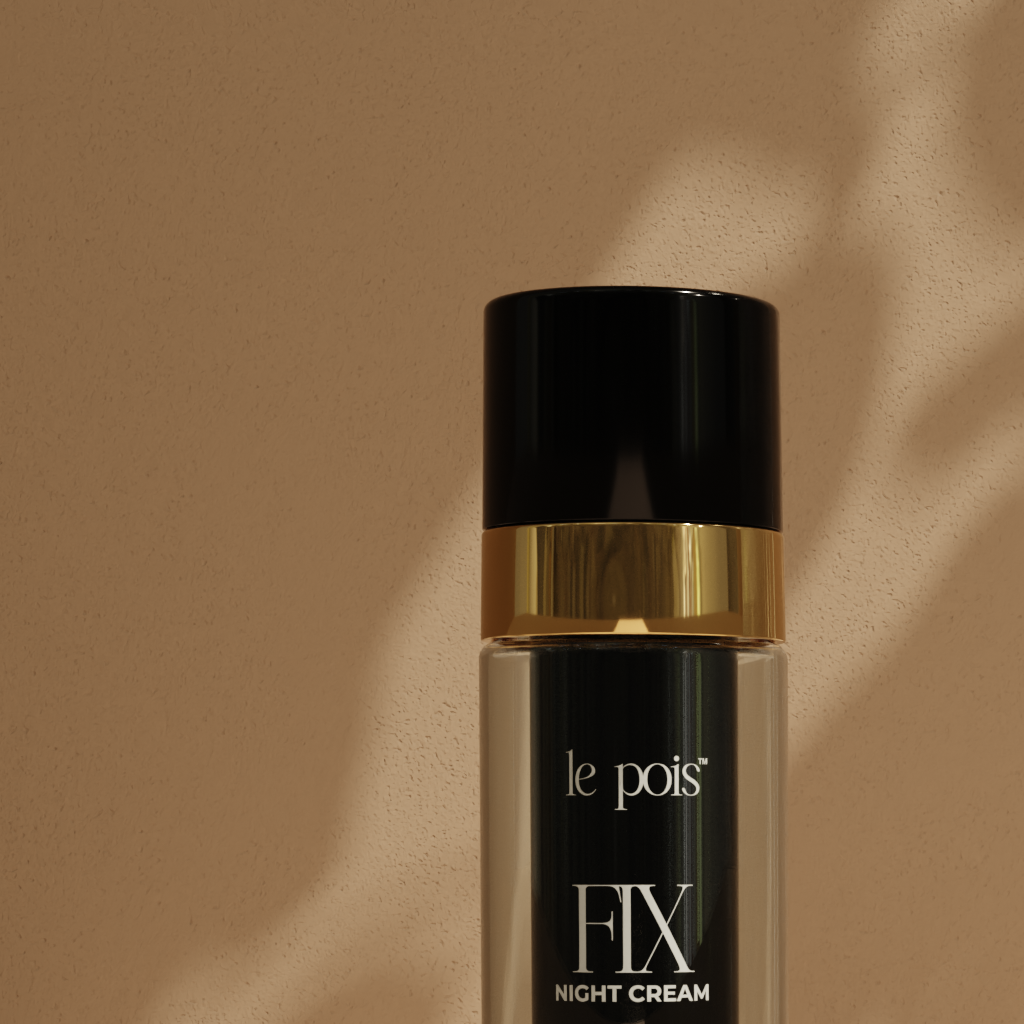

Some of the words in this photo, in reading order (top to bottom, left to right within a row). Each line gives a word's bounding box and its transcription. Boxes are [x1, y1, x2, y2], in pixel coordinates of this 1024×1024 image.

[565, 749, 597, 797] le
[572, 883, 696, 974] FIX
[555, 984, 623, 1003] NIGHT
[628, 983, 710, 1003] CREAM
